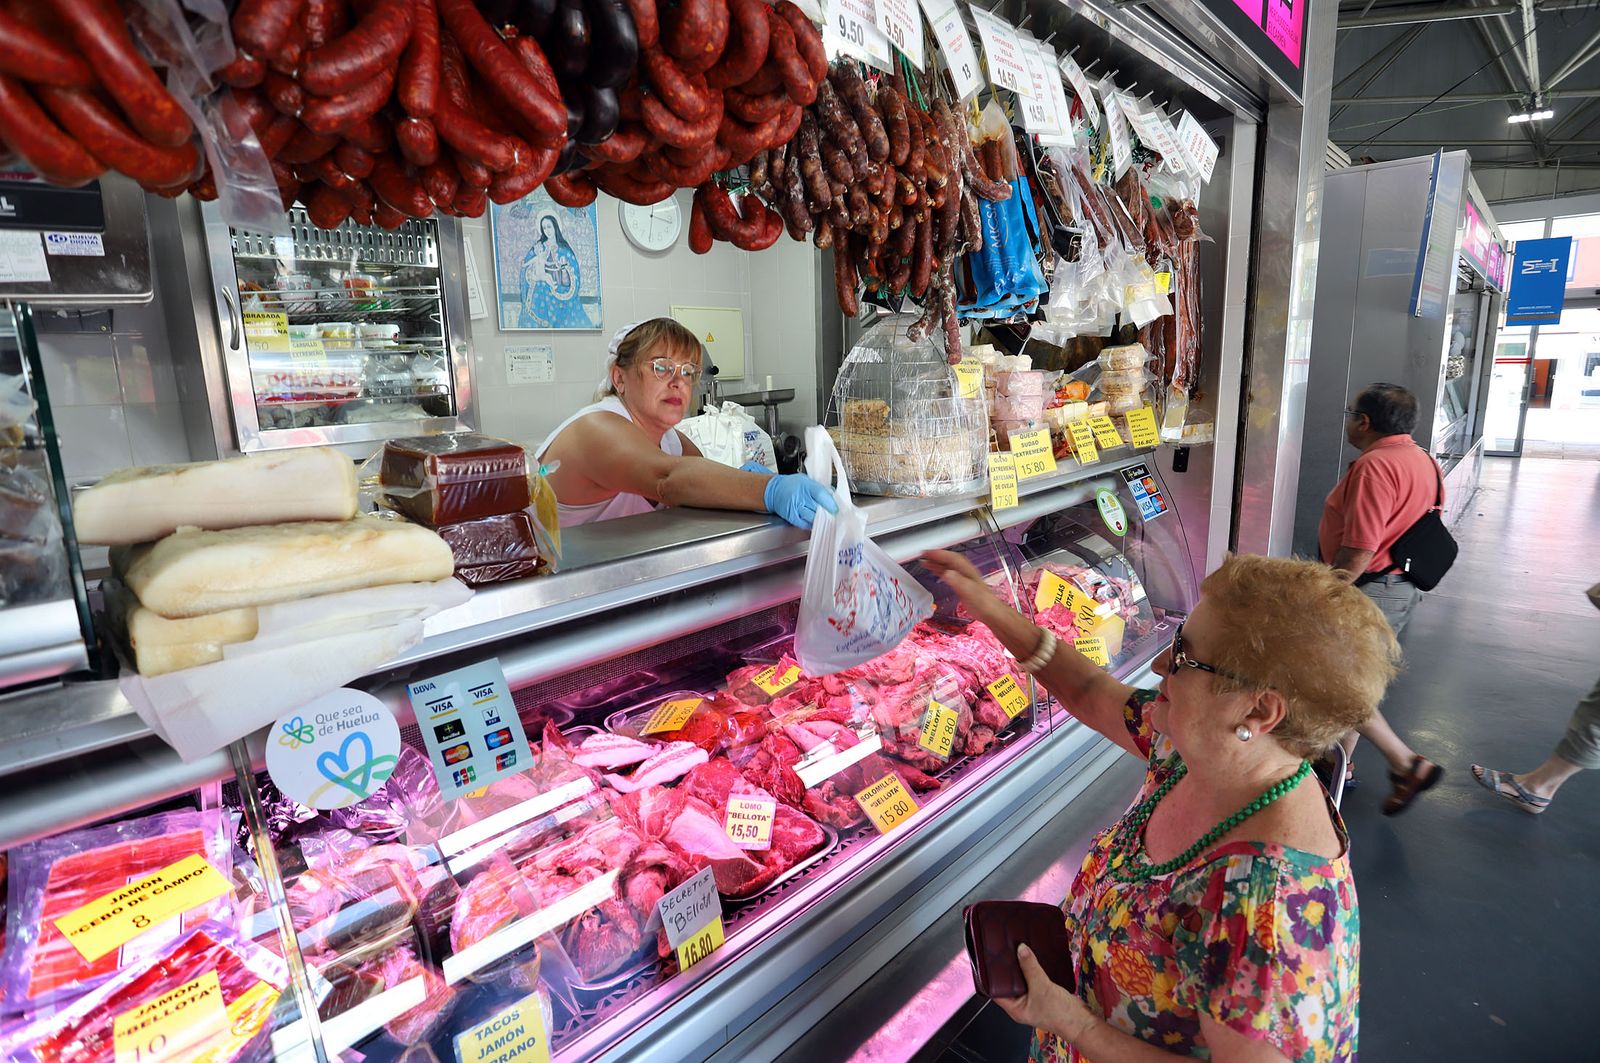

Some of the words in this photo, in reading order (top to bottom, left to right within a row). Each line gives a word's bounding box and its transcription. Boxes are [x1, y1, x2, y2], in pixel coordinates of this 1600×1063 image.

[838, 14, 864, 47] 9.50
[884, 15, 905, 49] 9.50
[962, 63, 972, 81] 13
[1019, 431, 1039, 440] QUESO
[1131, 482, 1144, 493] VISA
[1141, 500, 1153, 512] VISA
[1075, 638, 1100, 646] ABANICOS
[413, 682, 437, 696] BBVA
[993, 677, 1010, 690] PLUMAS
[473, 687, 494, 699] VISA
[315, 711, 341, 726] Que
[341, 705, 363, 719] sea
[431, 700, 454, 714] VISA
[318, 723, 334, 737] de
[336, 712, 381, 732] Huelva
[923, 709, 934, 735] PRESA
[860, 775, 897, 803] SOLOMILLOS
[739, 802, 762, 811] LOMO
[728, 812, 771, 822] "BELLOTA"
[730, 823, 759, 840] 15,50
[110, 877, 164, 905] JAMÓN
[70, 906, 123, 936] "CEBO
[128, 893, 150, 906] DE
[152, 865, 209, 895] CAMPO"
[131, 914, 151, 929] 8
[134, 982, 200, 1019] JAMÓN
[116, 985, 217, 1038] "BELLOTA"
[475, 1010, 520, 1041] TACOS
[477, 1025, 525, 1060] JAMÓN
